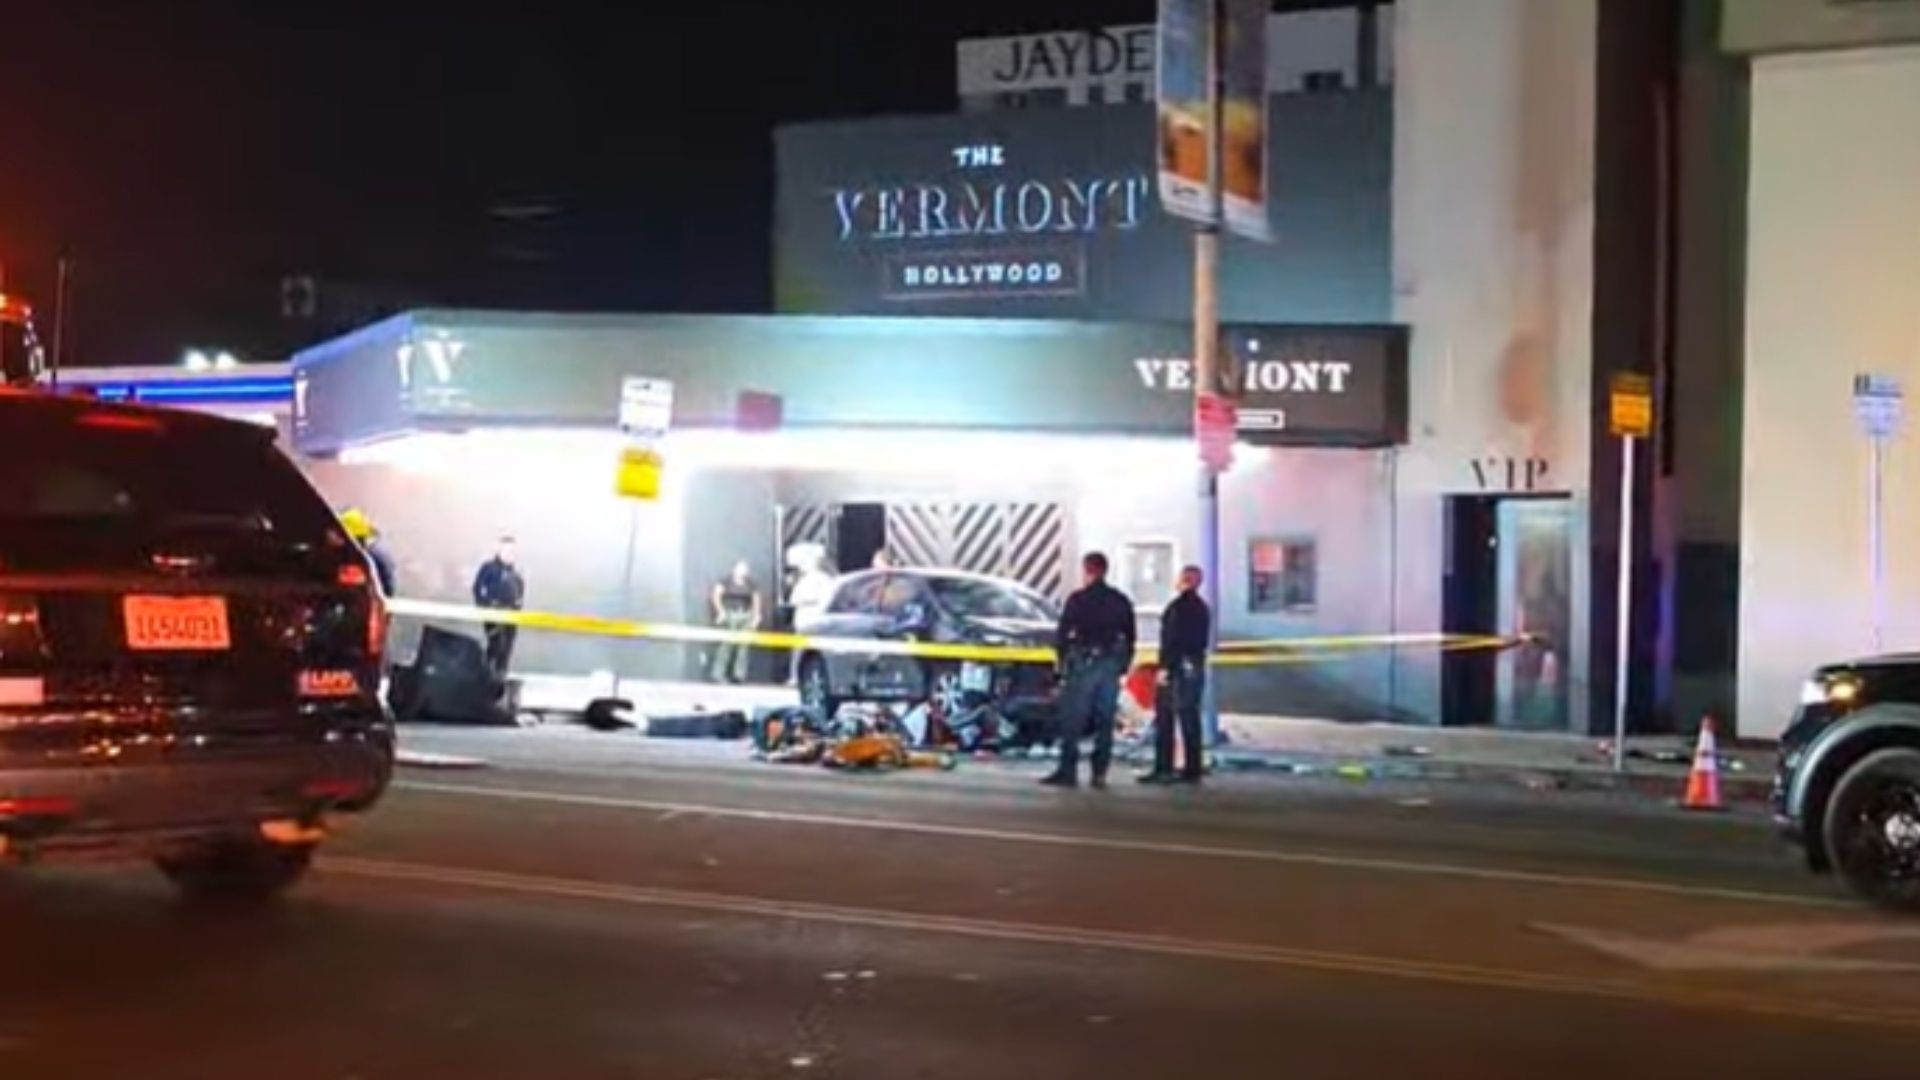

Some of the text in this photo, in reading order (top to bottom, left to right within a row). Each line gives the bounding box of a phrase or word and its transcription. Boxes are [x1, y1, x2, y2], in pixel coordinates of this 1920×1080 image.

[952, 145, 1006, 167] THE
[835, 174, 1149, 240] VERMONT
[903, 261, 1063, 287] HOLLYWOOD
[1133, 357, 1352, 393] VEONT
[1470, 457, 1549, 489] VIP
